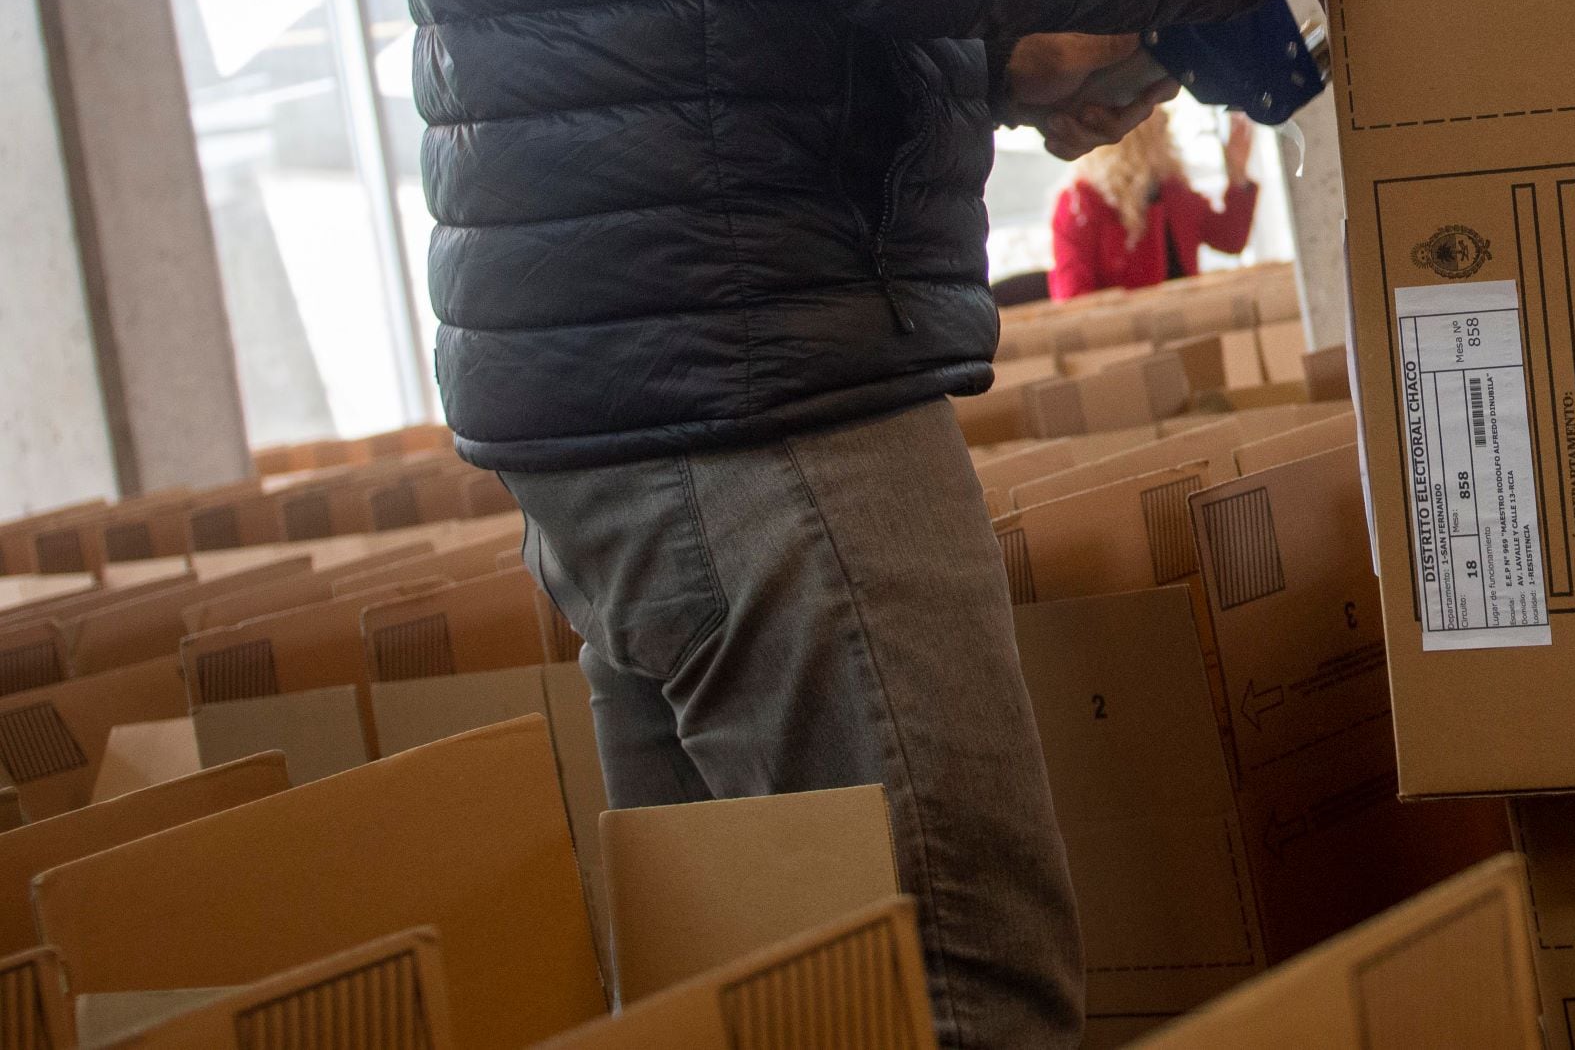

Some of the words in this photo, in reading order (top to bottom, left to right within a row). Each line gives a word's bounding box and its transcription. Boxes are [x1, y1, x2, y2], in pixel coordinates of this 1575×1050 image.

[1466, 316, 1481, 347] 858
[1454, 336, 1464, 362] Mesa
[1407, 360, 1419, 407] CHACO
[1490, 418, 1500, 453] ALFREDO
[1409, 416, 1428, 503] ELECTORAL
[1493, 455, 1503, 493] RODOLFO
[1457, 470, 1470, 499] 858
[1506, 469, 1516, 502] 13-RCIA
[1433, 483, 1446, 534] FERNANDO
[1450, 508, 1460, 532] Mesa:
[1510, 504, 1518, 528] CALLE
[1418, 507, 1436, 582] DISTRITO
[1439, 536, 1449, 565] 1-SAN
[1482, 526, 1496, 588] funcionamiento
[1501, 538, 1509, 554] 969
[1513, 537, 1522, 570] LAVALLE
[1522, 523, 1535, 585] 1-RESISTENCIA
[1466, 559, 1478, 578] 18
[1516, 572, 1524, 586] AV.
[1442, 568, 1456, 629] Departamento:
[1459, 594, 1469, 627] Circuito:
[1489, 590, 1497, 600] de
[1490, 602, 1501, 626] Lugar
[1092, 695, 1107, 719] 2
